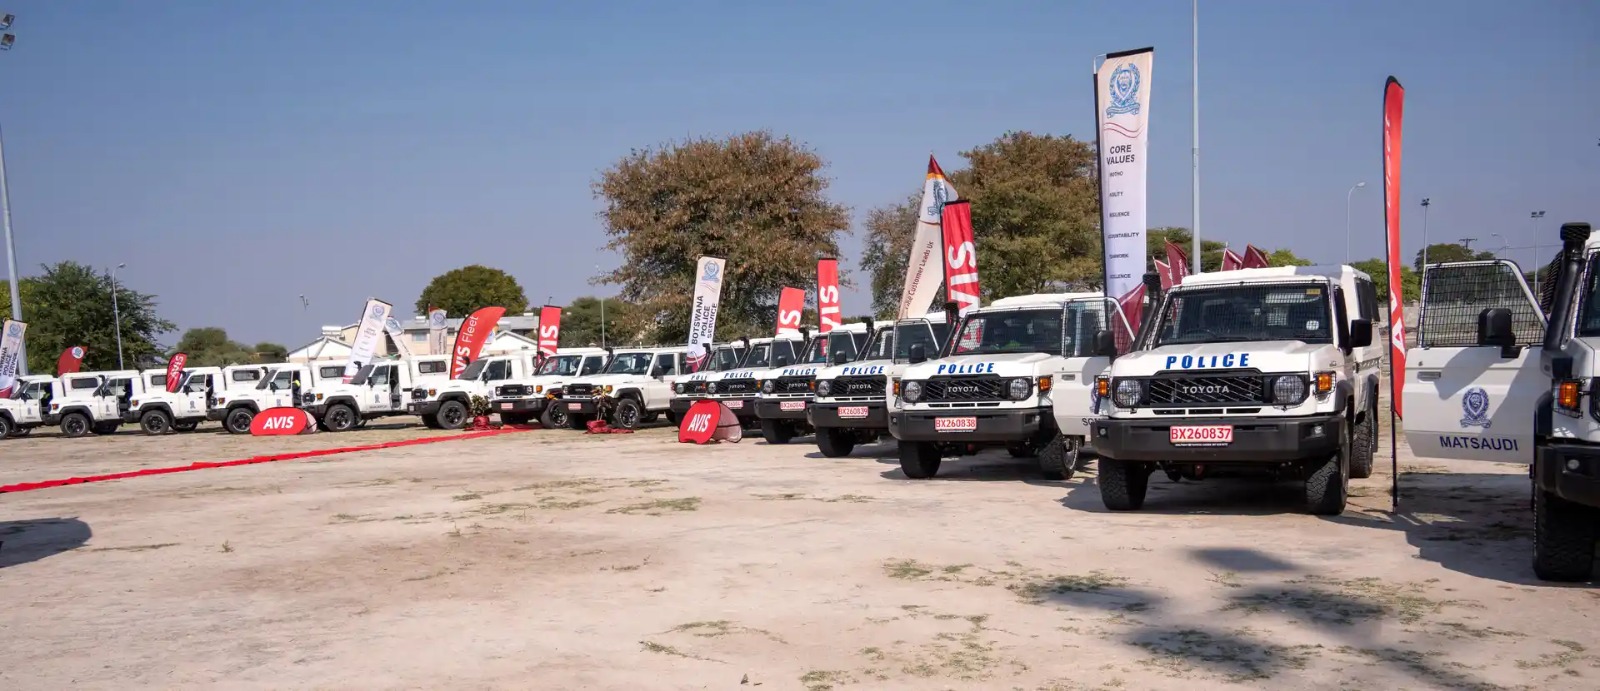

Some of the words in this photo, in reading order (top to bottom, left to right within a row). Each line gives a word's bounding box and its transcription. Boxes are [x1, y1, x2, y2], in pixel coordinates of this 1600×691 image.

[1110, 145, 1132, 154] CORE
[1107, 154, 1135, 165] VALUES
[908, 266, 924, 296] Customer
[919, 248, 931, 267] Leads
[691, 295, 704, 345] BOTSWANA
[700, 305, 711, 337] POLICE
[707, 303, 718, 339] SERVICE
[461, 316, 479, 343] Fleet
[937, 362, 995, 375] POLICE
[1165, 353, 1250, 370] POLICE
[782, 368, 817, 376] POLICE
[842, 365, 885, 375] POLICE
[1182, 385, 1230, 394] TOYOTA
[263, 415, 295, 430] AVIS
[687, 413, 712, 433] AVIS
[935, 418, 976, 428] BX260838
[1171, 427, 1231, 440] BX260837
[1439, 435, 1519, 452] MATSAUDI
